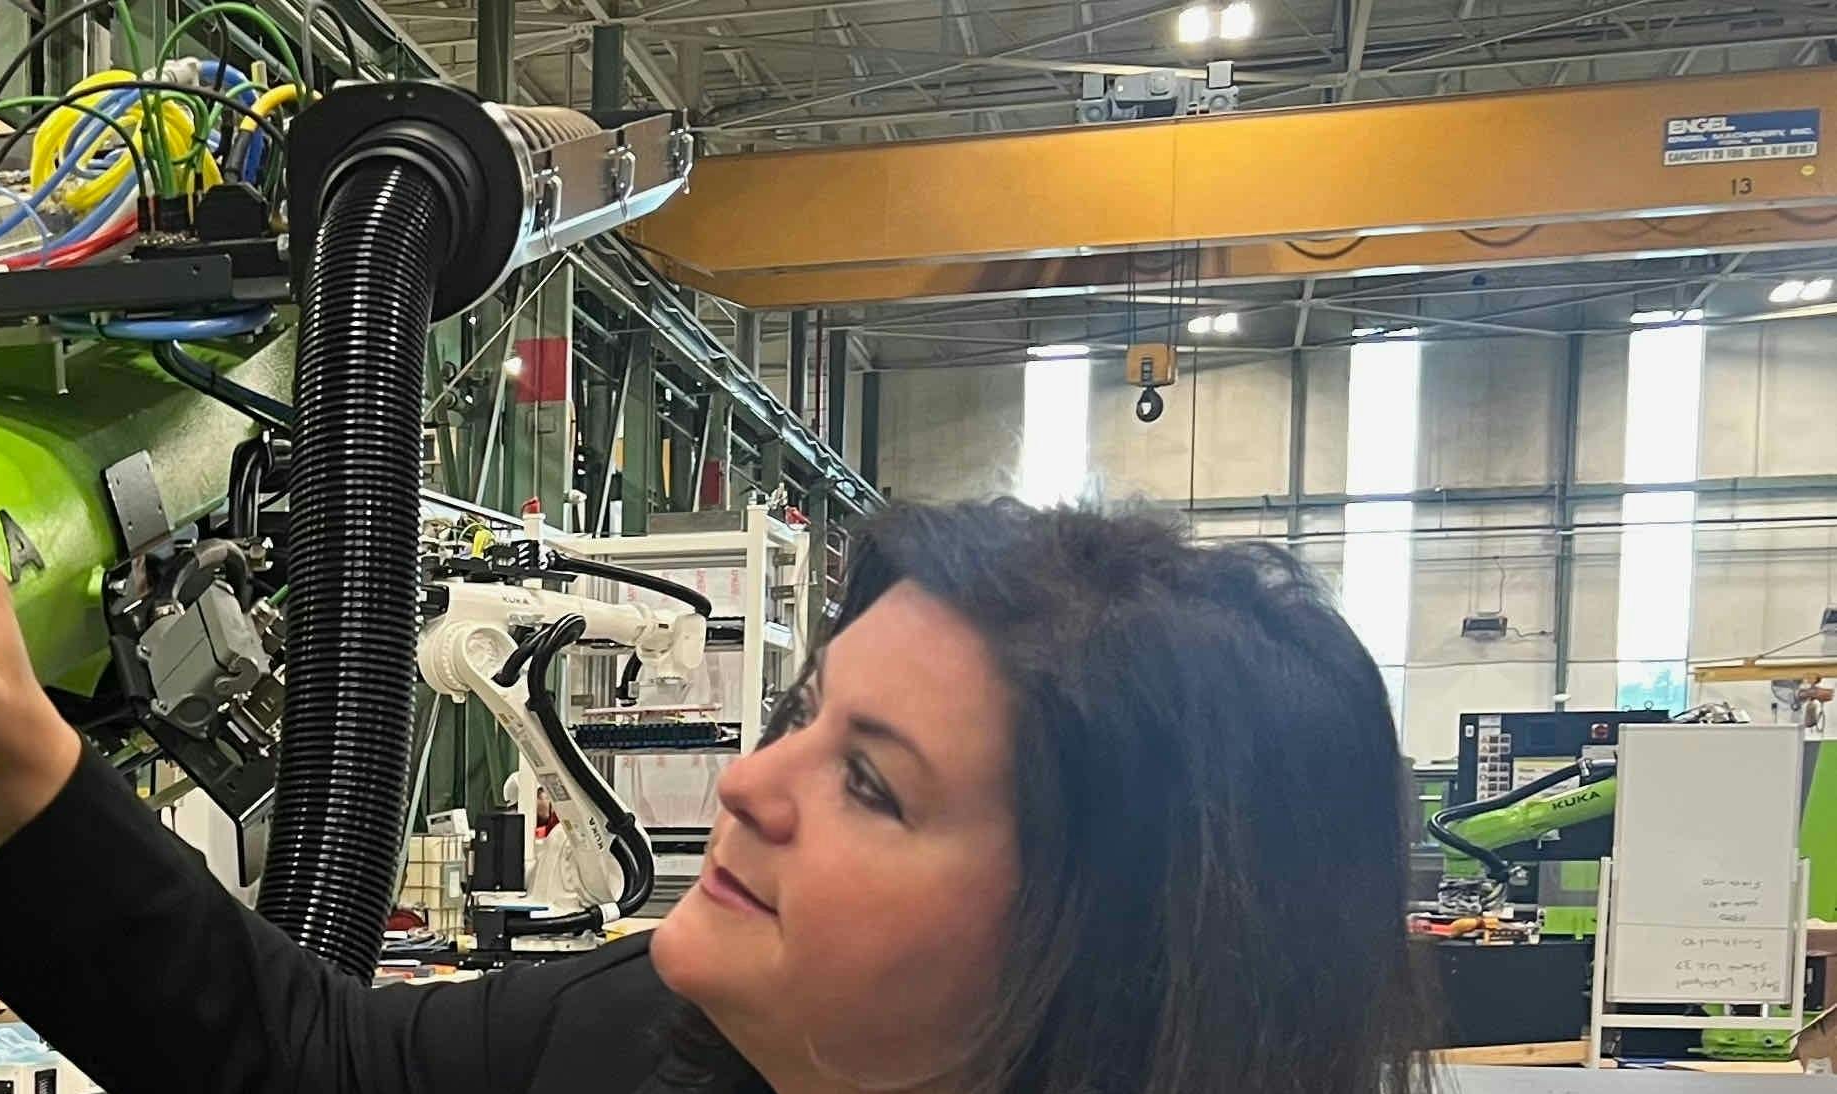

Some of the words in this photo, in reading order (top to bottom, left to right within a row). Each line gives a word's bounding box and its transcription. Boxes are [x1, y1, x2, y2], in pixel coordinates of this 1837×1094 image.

[1668, 117, 1735, 134] ENGEL
[1732, 178, 1753, 195] 13
[1552, 791, 1602, 810] KUKA
[588, 816, 604, 851] KUKA
